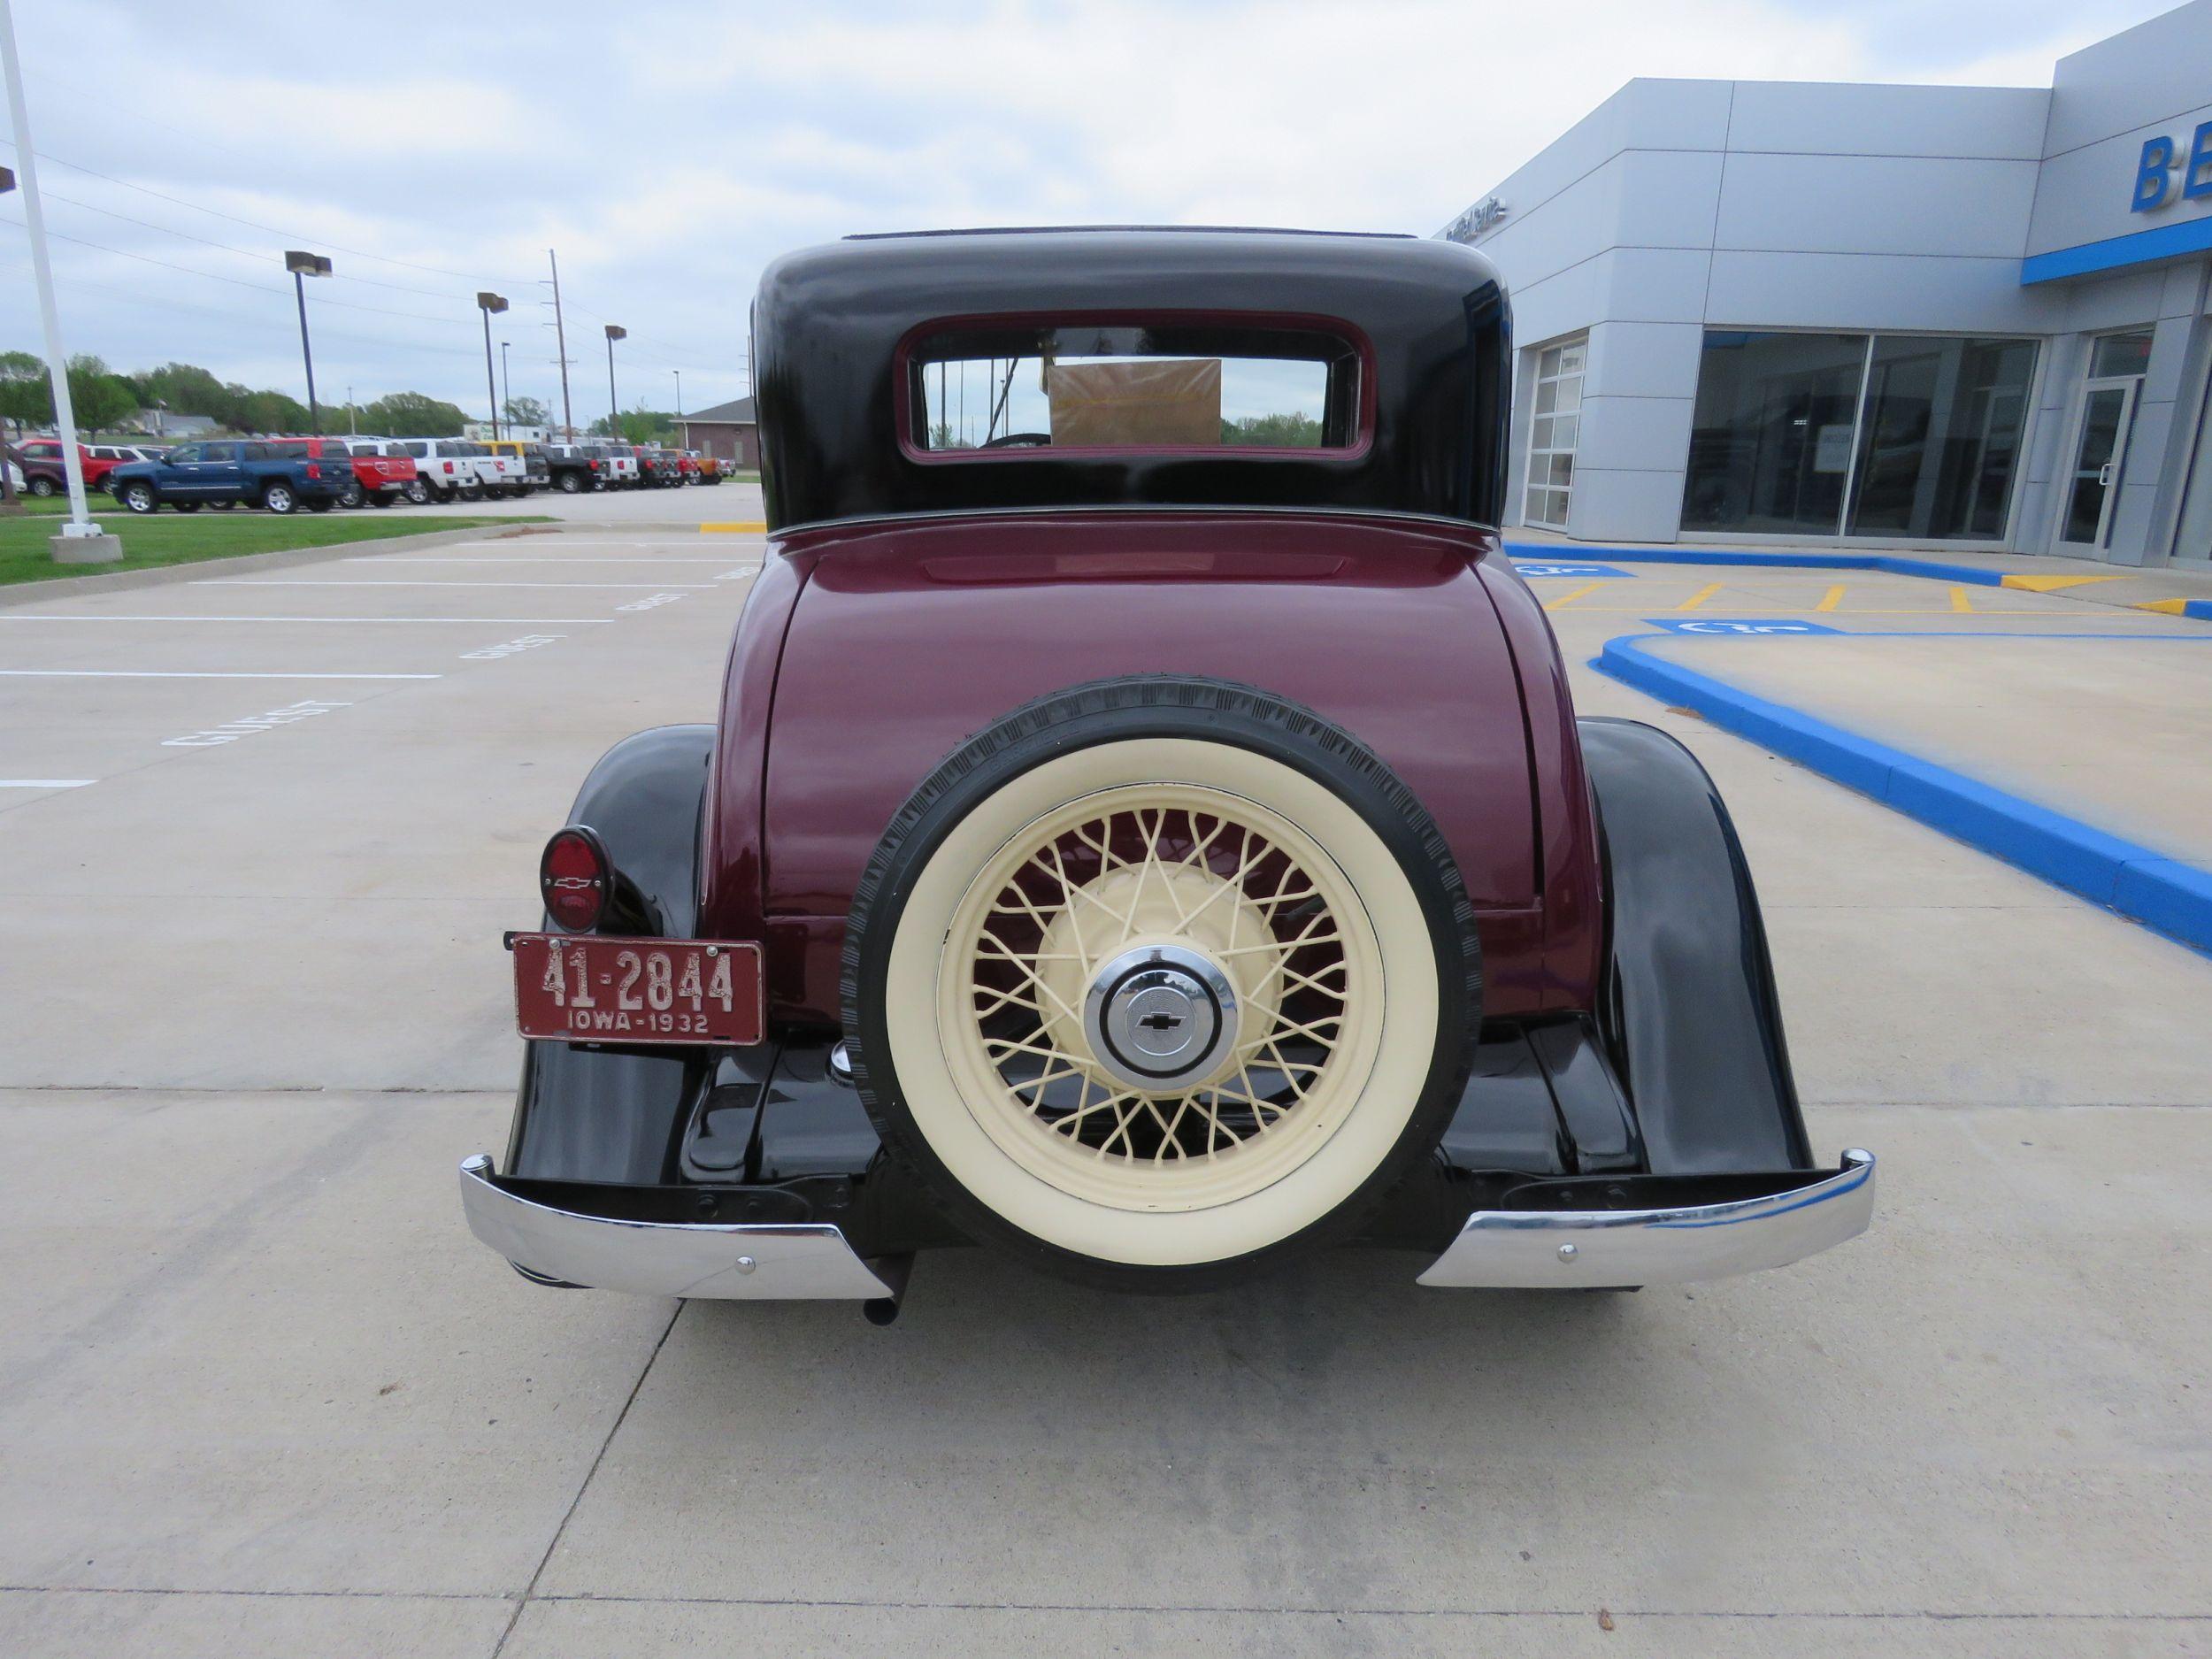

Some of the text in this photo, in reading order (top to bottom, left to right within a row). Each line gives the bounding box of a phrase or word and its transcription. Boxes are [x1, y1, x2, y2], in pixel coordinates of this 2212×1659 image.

[160, 700, 354, 747] GUEST
[541, 944, 733, 1013] 41-2844
[567, 1010, 709, 1034] IOWA-1932
